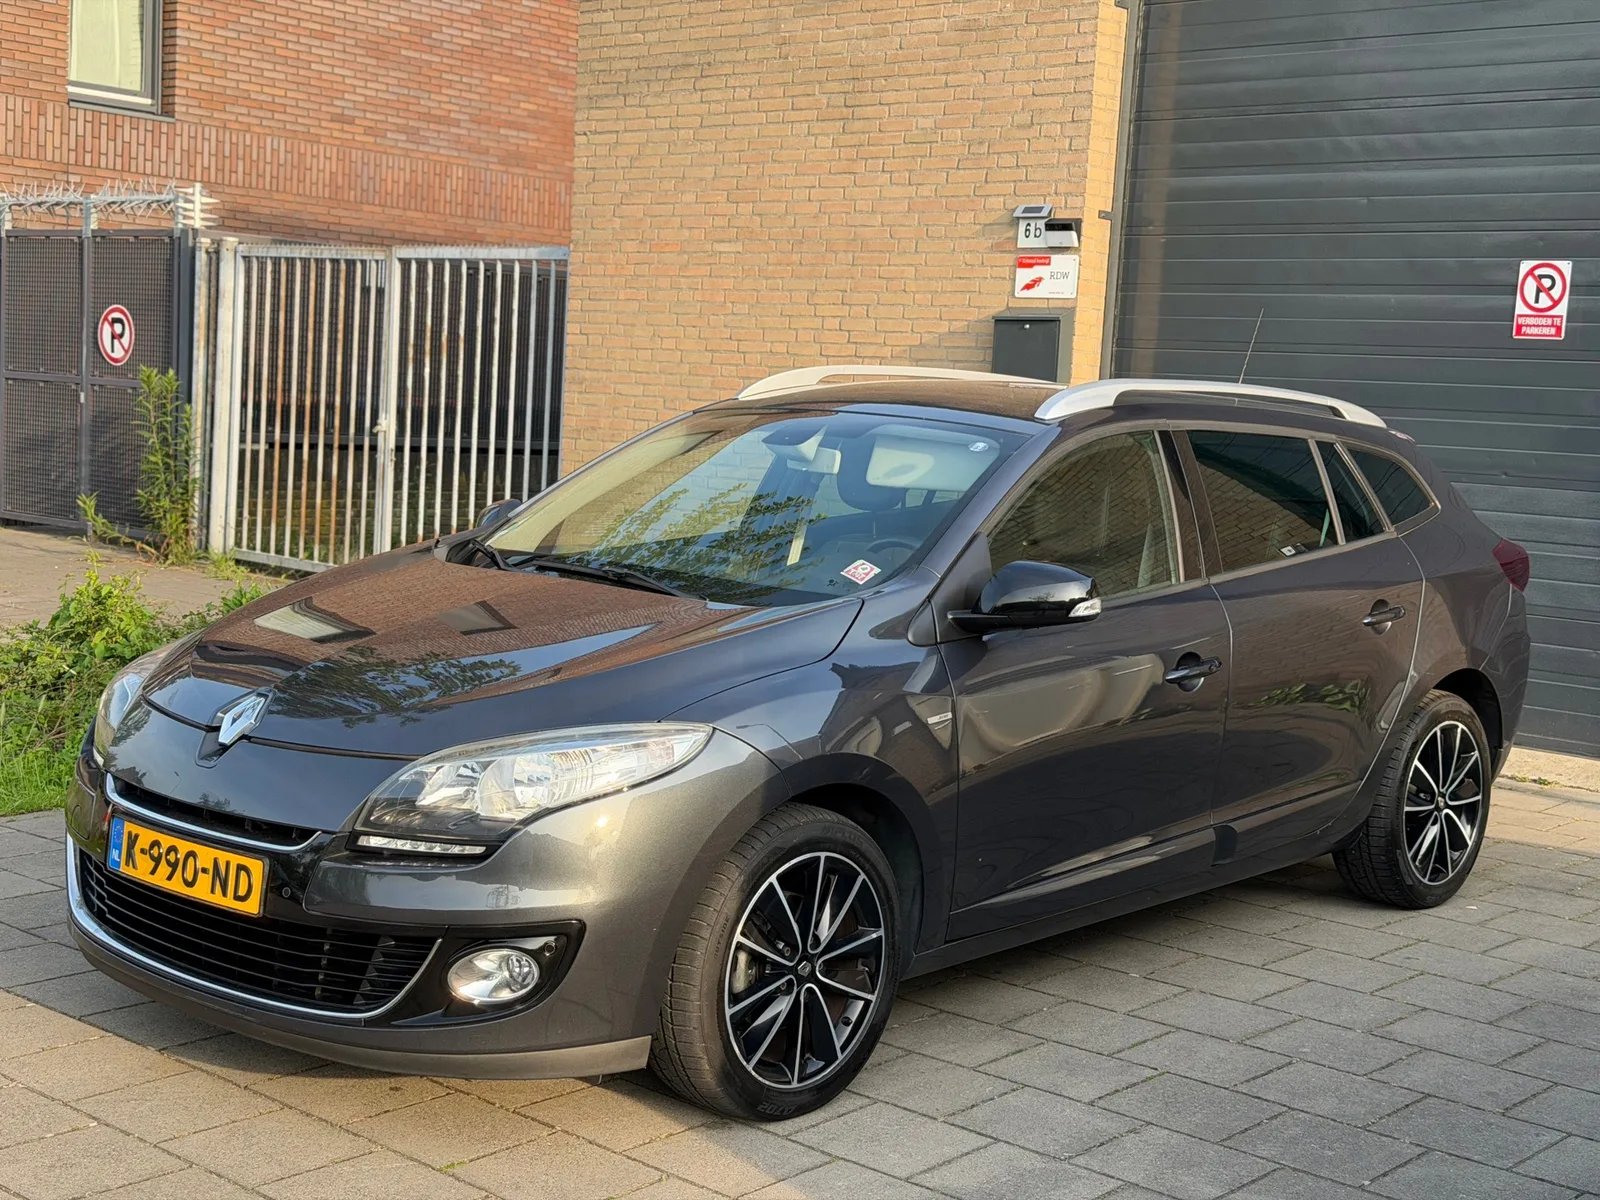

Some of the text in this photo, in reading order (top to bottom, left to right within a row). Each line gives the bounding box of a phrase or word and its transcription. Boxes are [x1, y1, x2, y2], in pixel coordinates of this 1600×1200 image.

[1049, 271, 1070, 280] RDW
[1517, 316, 1562, 326] VERBODEN TE
[1521, 326, 1556, 335] PARKEREN
[112, 848, 120, 862] NL
[125, 830, 254, 903] K-990-ND
